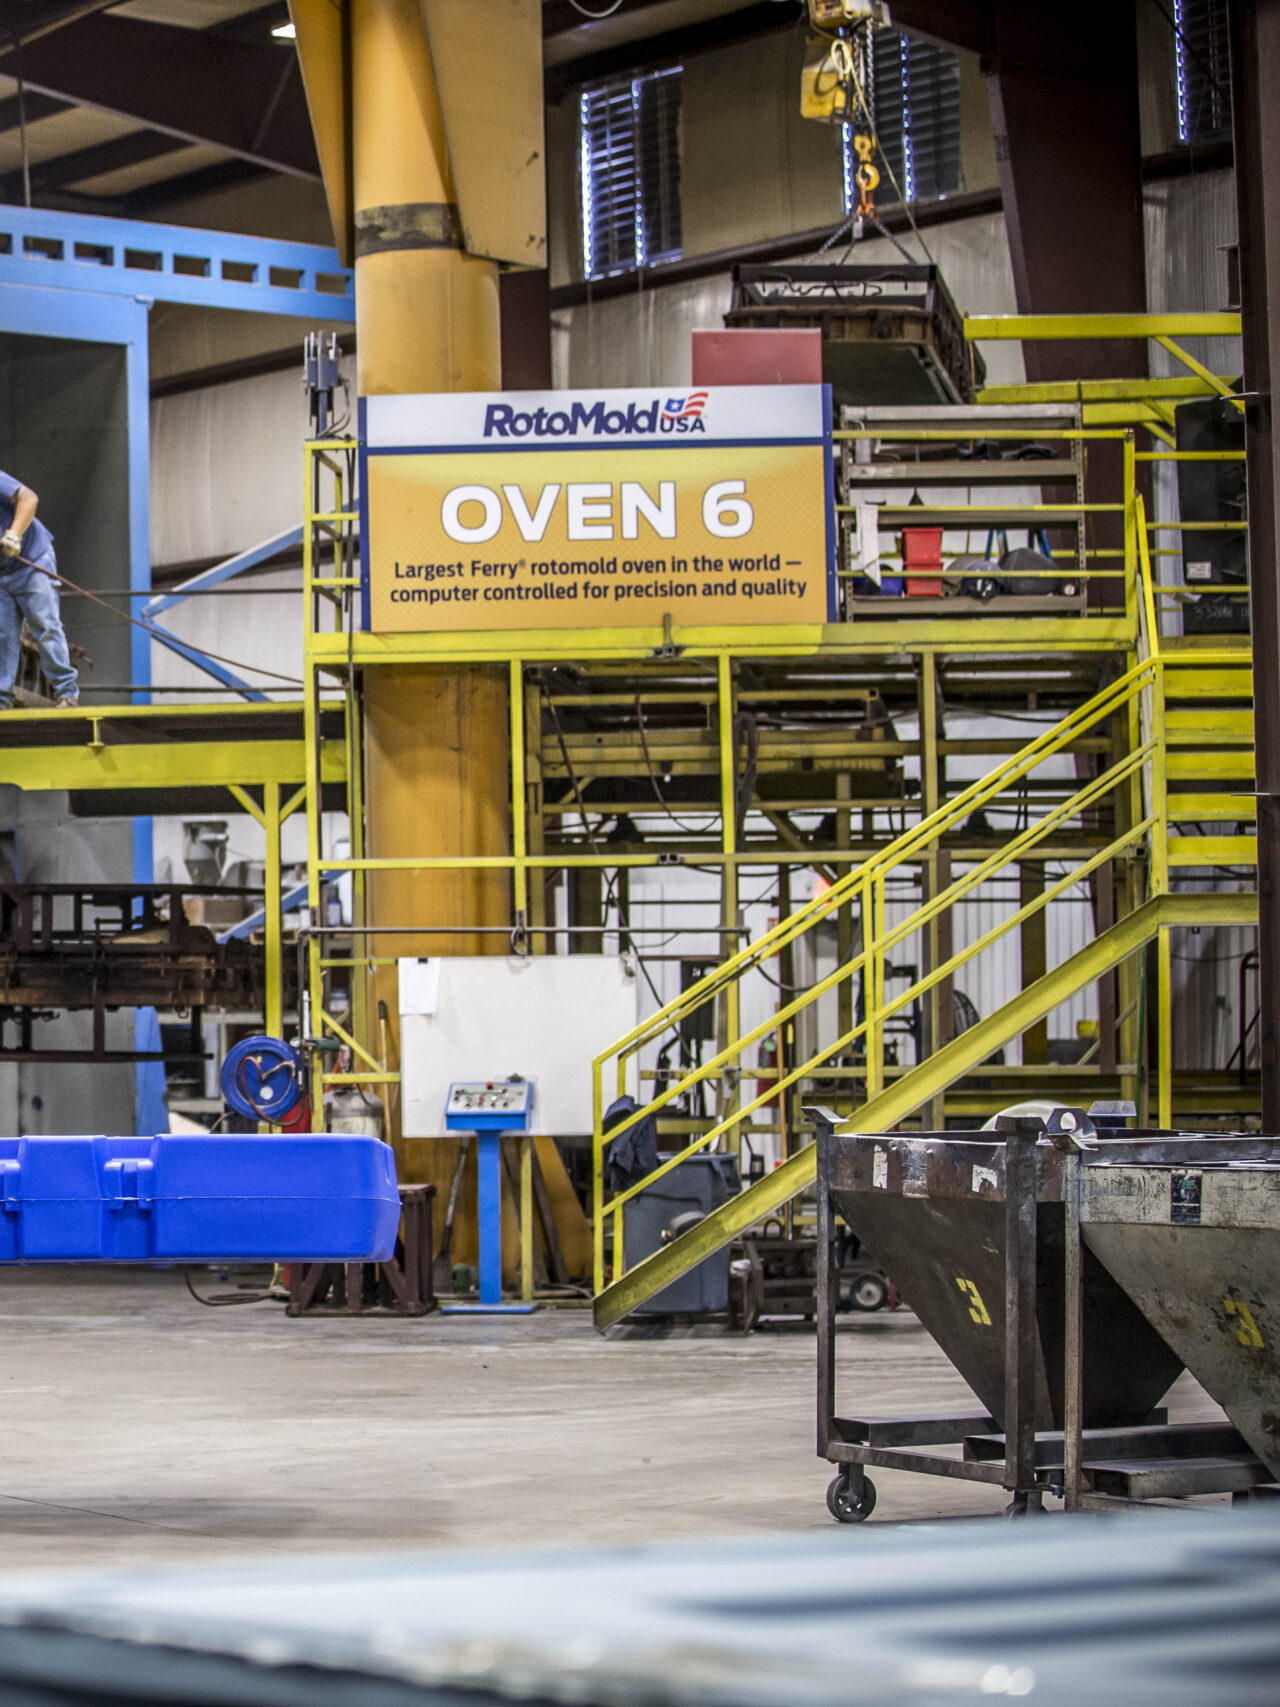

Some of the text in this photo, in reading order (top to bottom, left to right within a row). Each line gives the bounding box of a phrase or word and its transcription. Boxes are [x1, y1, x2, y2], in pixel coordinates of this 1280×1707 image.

[483, 400, 706, 437] RotoMold USA
[441, 480, 754, 543] OVEN 6
[394, 561, 464, 581] Largest
[531, 557, 617, 575] rotomold
[622, 559, 666, 573] oven
[671, 556, 687, 573] in
[693, 555, 723, 571] the
[728, 554, 780, 571] world
[390, 578, 807, 605] computer controlled for precision and quality
[956, 1278, 992, 1326] 3
